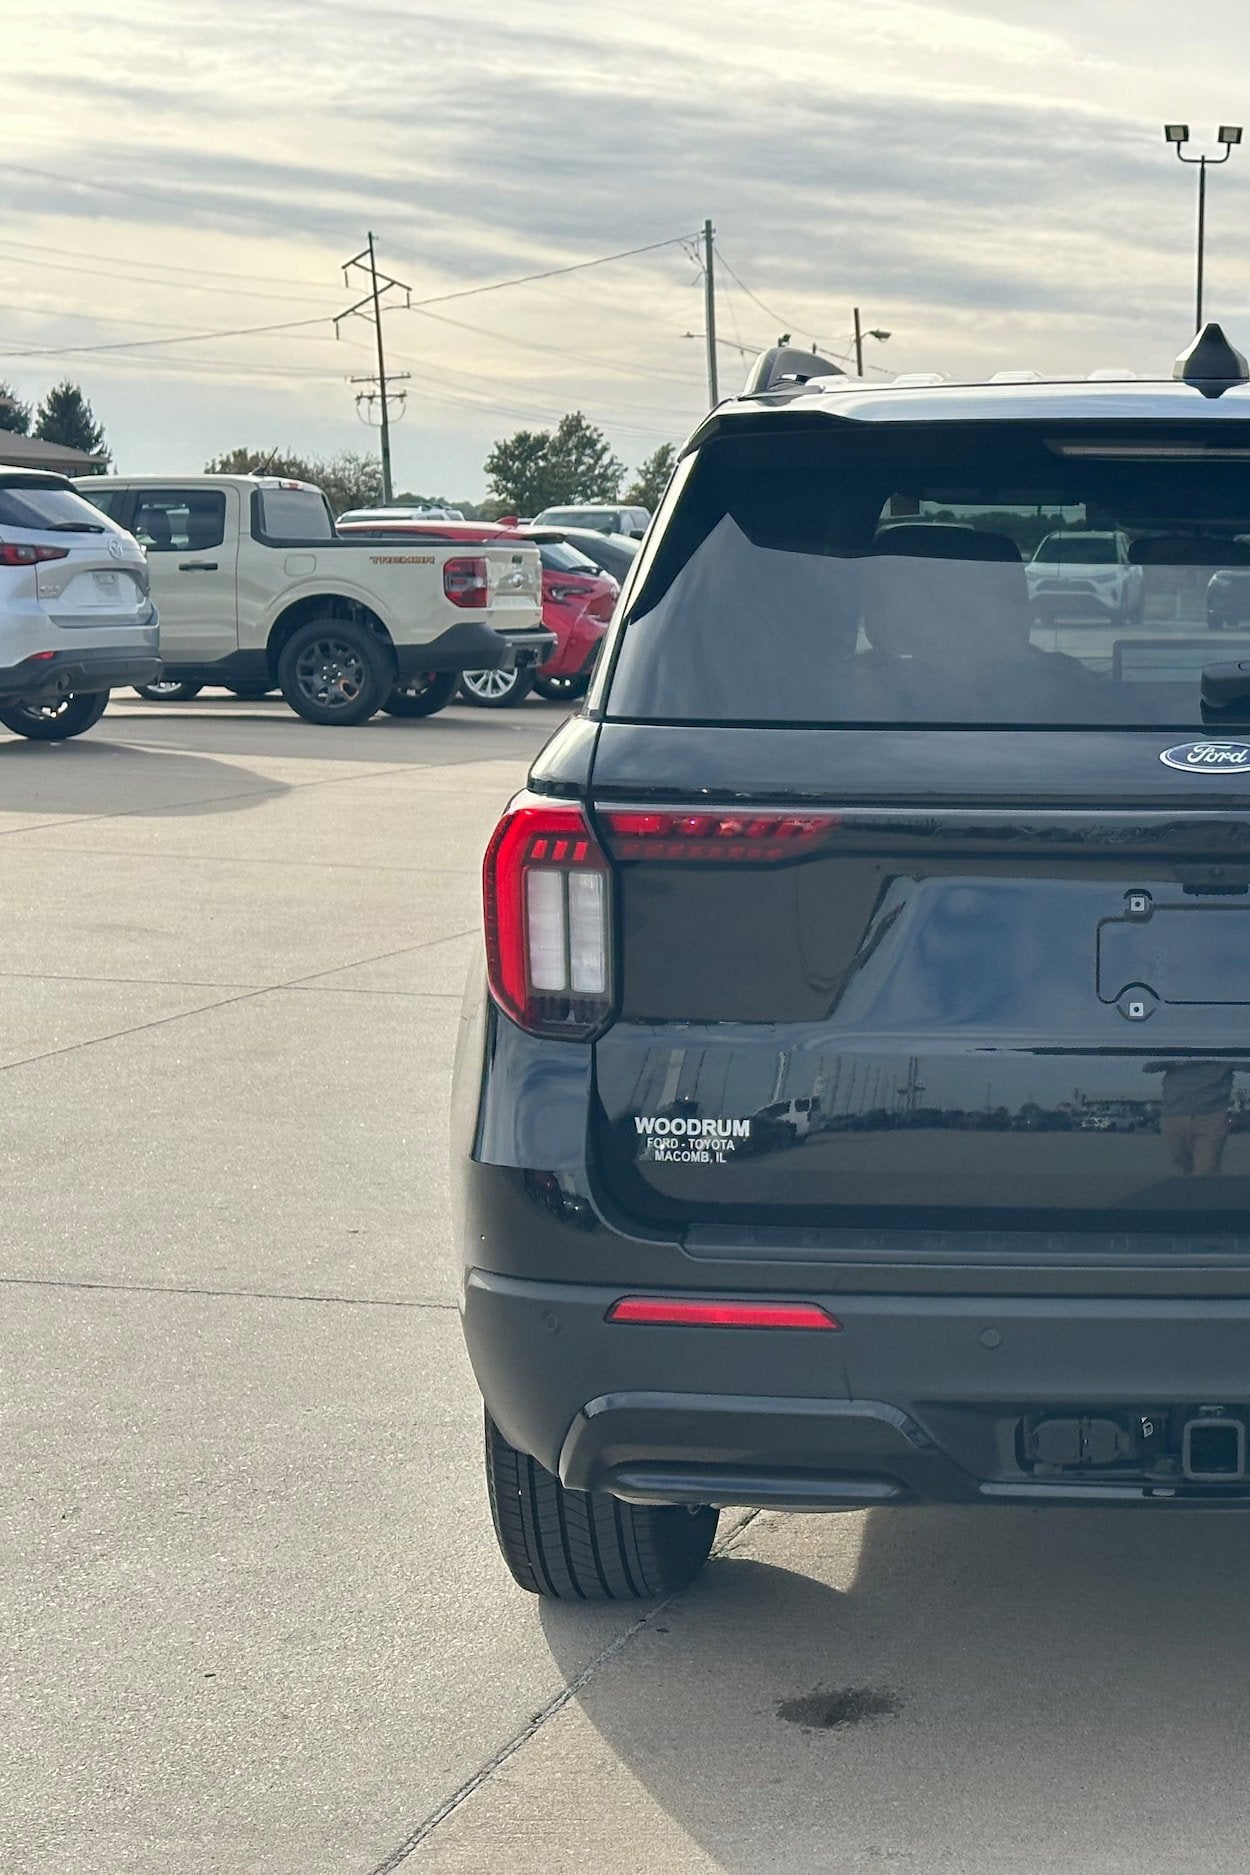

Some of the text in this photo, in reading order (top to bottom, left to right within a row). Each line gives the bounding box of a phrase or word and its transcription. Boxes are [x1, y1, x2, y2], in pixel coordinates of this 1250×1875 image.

[1187, 744, 1249, 763] Ford
[634, 1116, 751, 1137] WOODRUM
[647, 1137, 679, 1149] FORD
[688, 1138, 735, 1151] TOYOTA
[654, 1150, 727, 1164] MACOMB, IL
